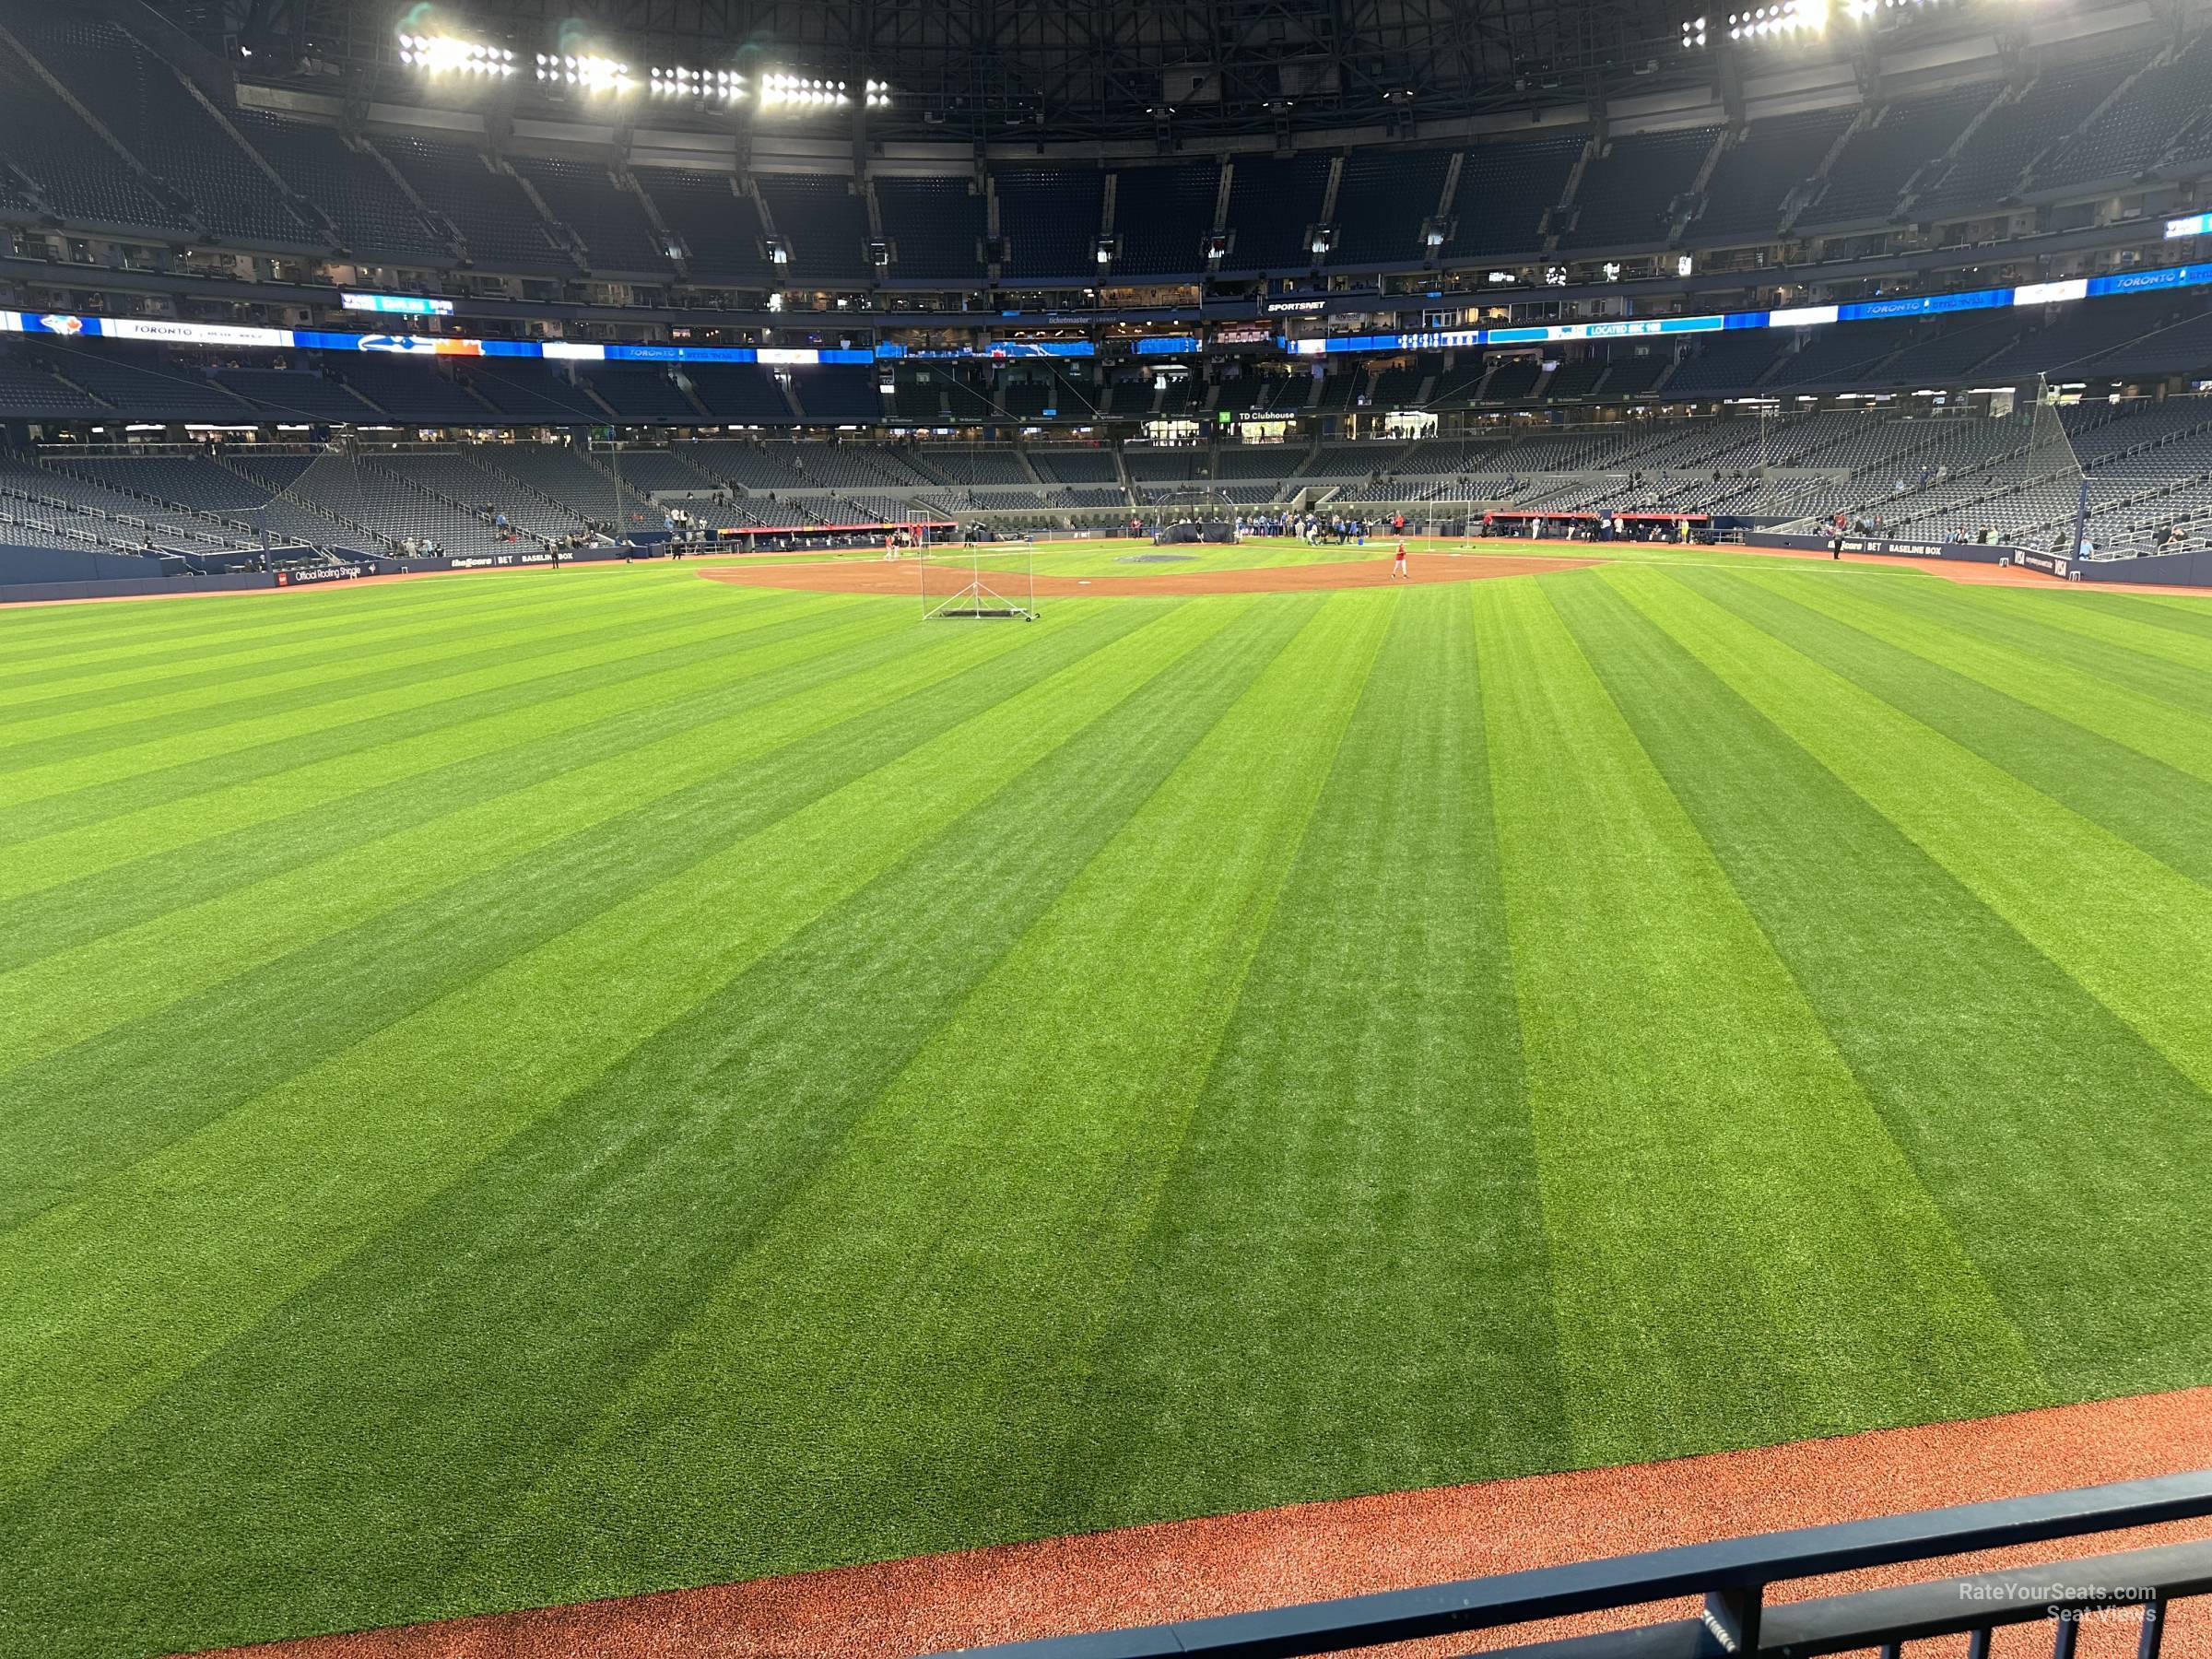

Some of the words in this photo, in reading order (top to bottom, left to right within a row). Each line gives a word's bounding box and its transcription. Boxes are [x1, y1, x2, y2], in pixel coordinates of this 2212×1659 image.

[2117, 273, 2175, 288] TORONTO
[1267, 301, 1325, 312] SPORTSNET
[1866, 302, 1919, 313] TORONTO
[135, 324, 192, 335] TORONTO
[1867, 542, 1881, 551] BET
[1889, 545, 1924, 554] BASELINE
[1925, 547, 1941, 555] BOX
[452, 557, 492, 567] theScore
[498, 555, 512, 564] BET
[522, 554, 552, 562] BASELIN
[296, 570, 317, 581] Official
[317, 568, 340, 579] Roofing
